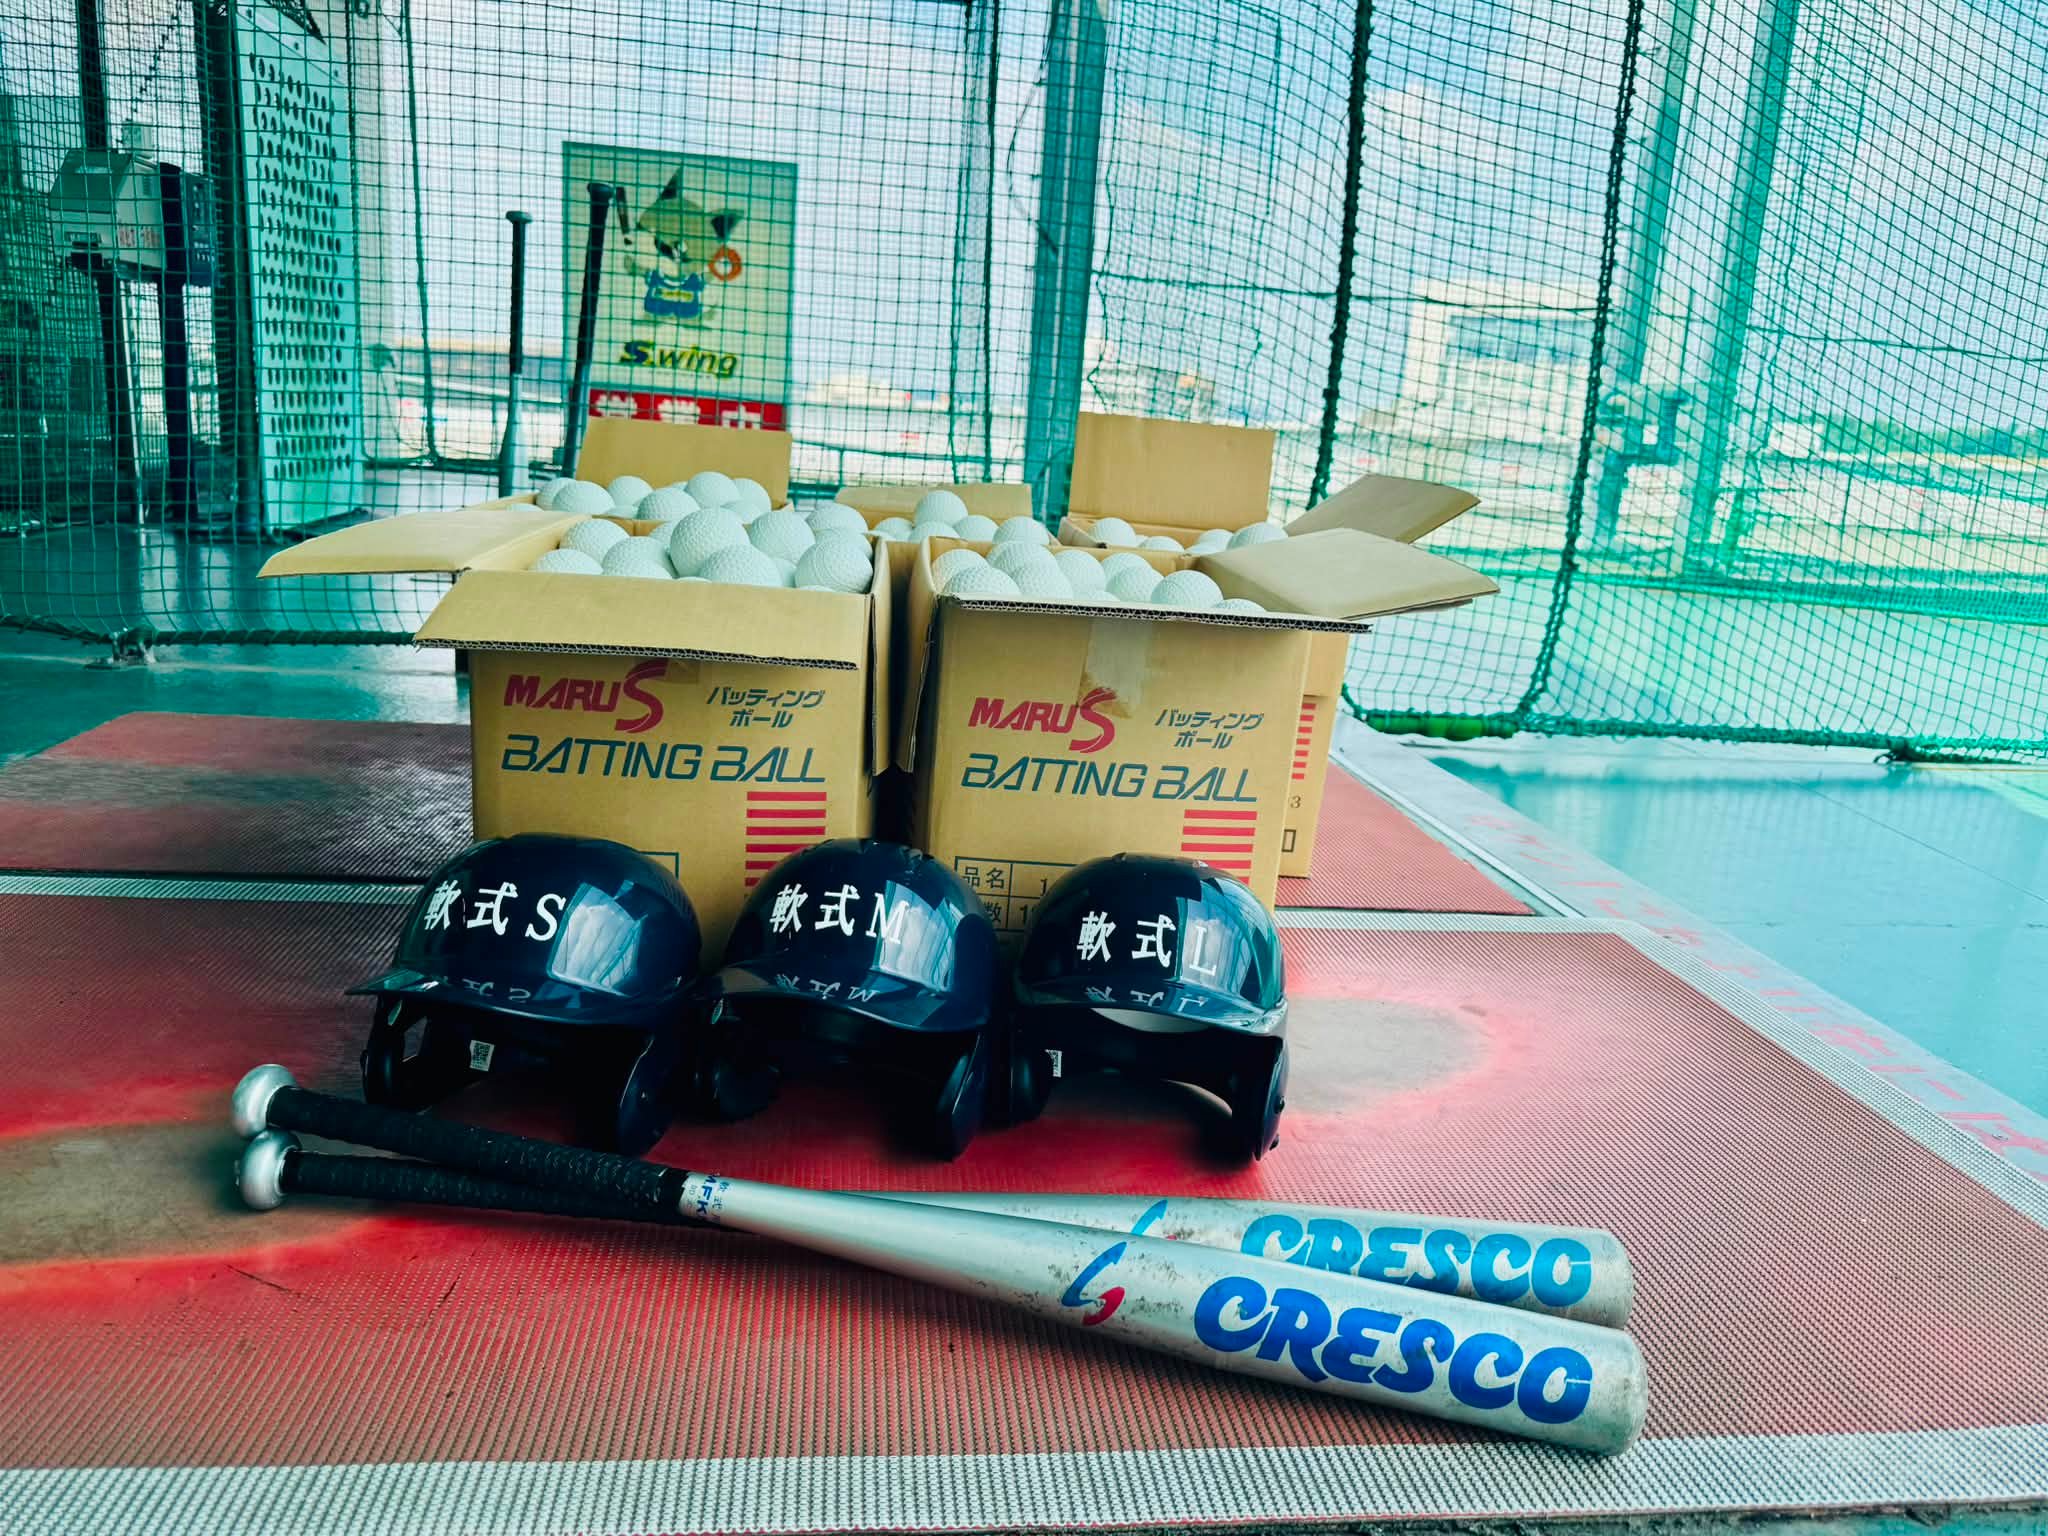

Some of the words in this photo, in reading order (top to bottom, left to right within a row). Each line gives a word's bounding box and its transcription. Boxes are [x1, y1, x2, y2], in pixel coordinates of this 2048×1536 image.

[619, 339, 739, 380] Swing
[706, 686, 826, 708] バッティング
[729, 708, 793, 728] ボール
[1154, 709, 1264, 730] バッティング
[1173, 731, 1233, 749] ボール
[501, 733, 703, 780] BATTING
[709, 745, 826, 783] BALL
[960, 752, 1149, 798] BATTING
[1151, 765, 1258, 803] BALL
[961, 866, 1005, 889] 品名
[1241, 1213, 1593, 1308] CRESCO
[1194, 1275, 1593, 1425] CRESCO
